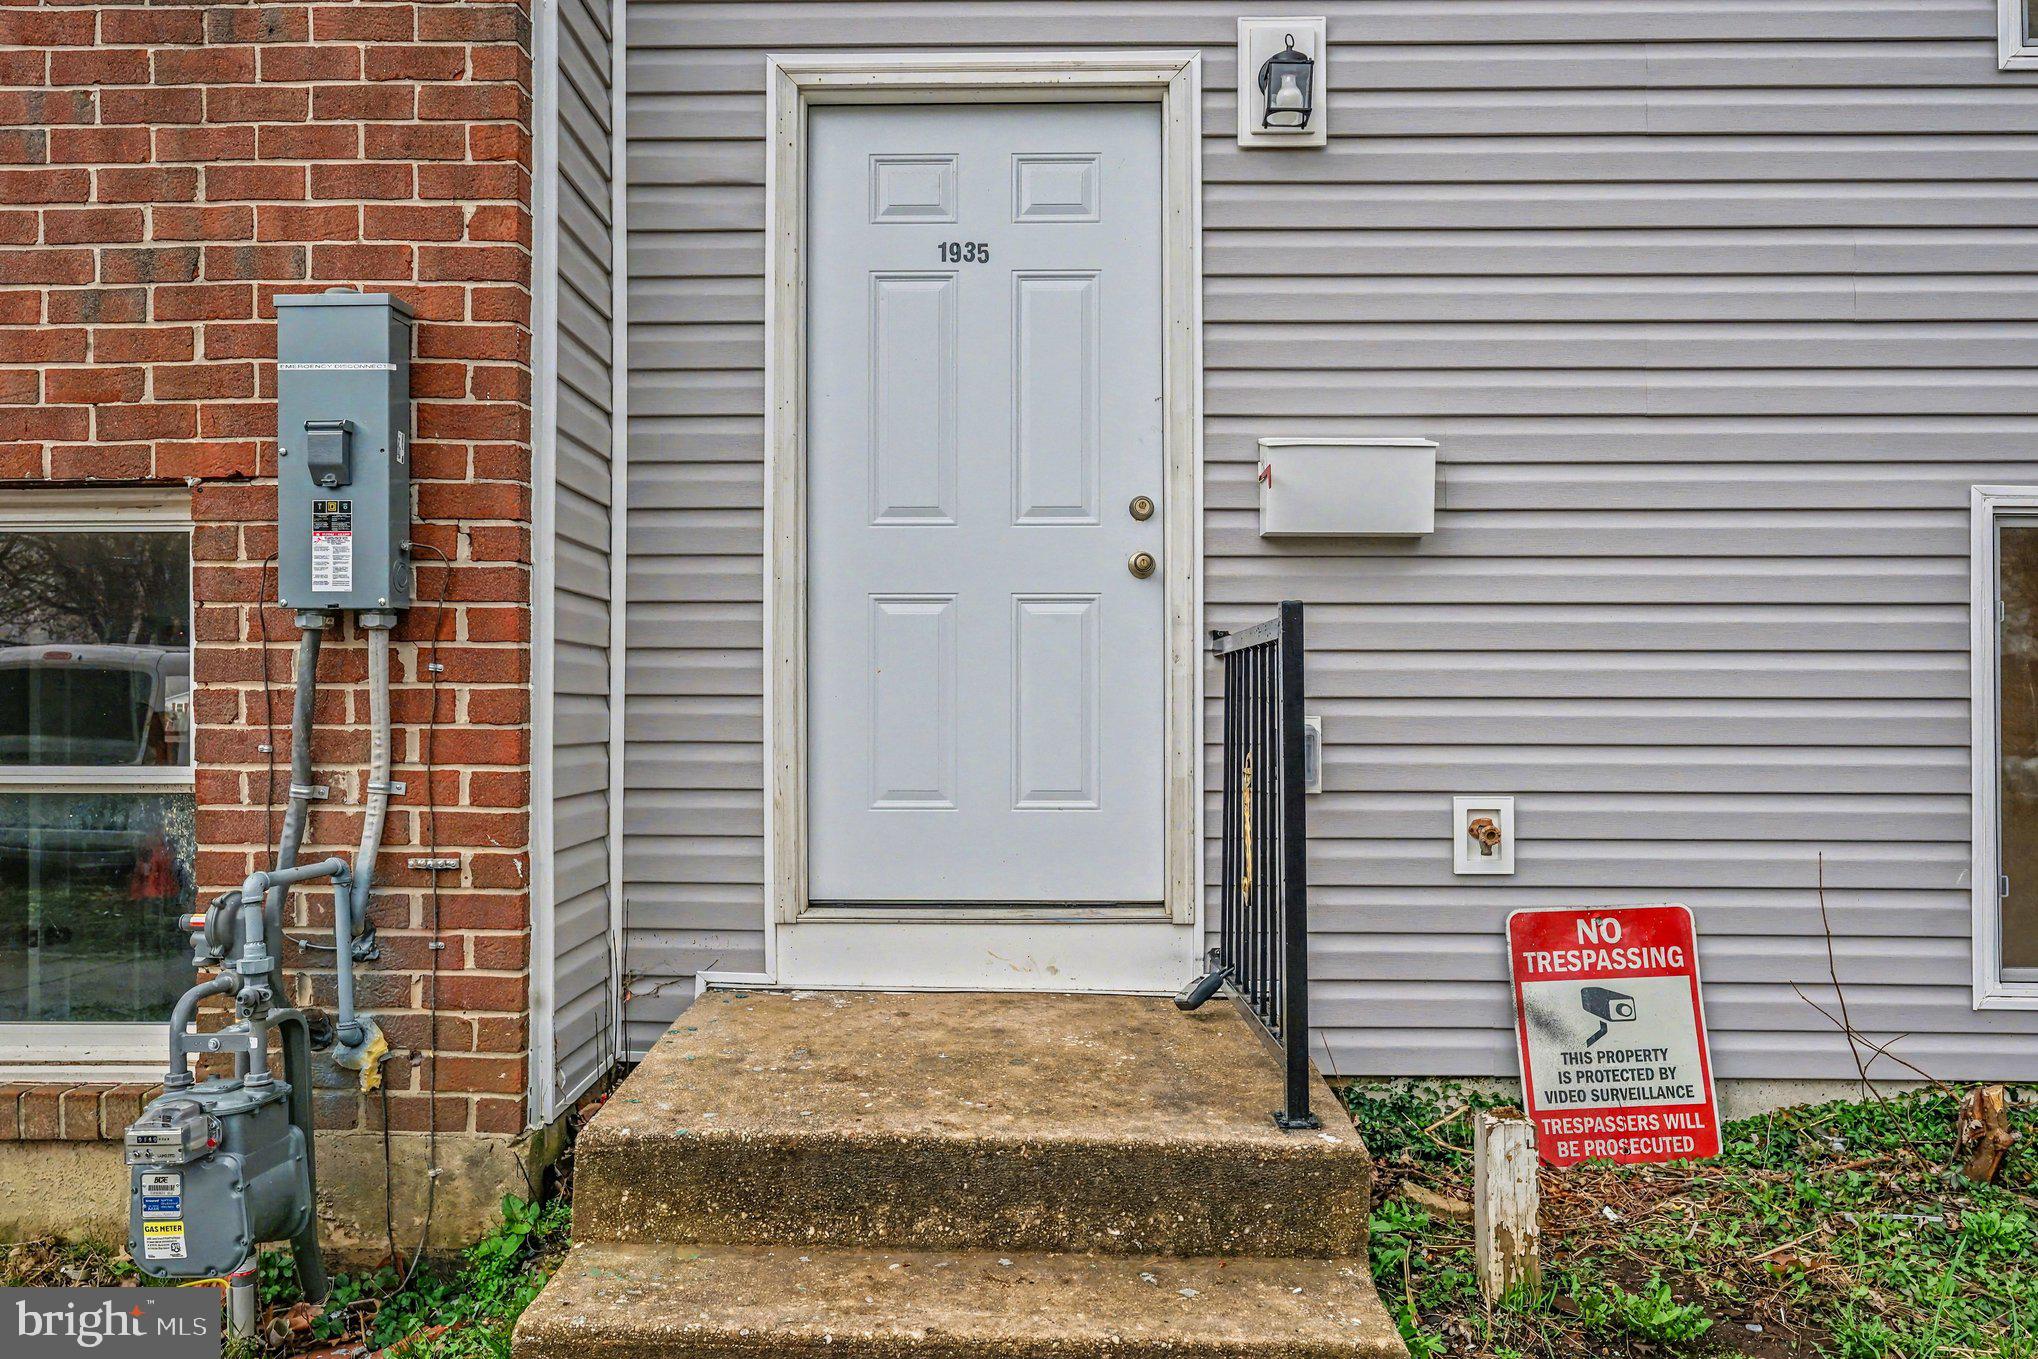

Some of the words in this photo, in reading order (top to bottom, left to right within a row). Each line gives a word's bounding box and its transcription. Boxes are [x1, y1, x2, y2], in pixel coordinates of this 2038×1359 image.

[937, 241, 990, 264] 1935
[1577, 917, 1623, 945] NO
[1522, 946, 1685, 974] TRESPASSING
[1560, 1051, 1593, 1066] THIS
[1597, 1048, 1669, 1065] PROPERTY
[1558, 1071, 1572, 1085] IS
[1576, 1068, 1654, 1085] PROTECTED
[1659, 1066, 1677, 1081] BY
[1544, 1089, 1587, 1104] VIDEO
[1591, 1085, 1695, 1103] SURVEILLANCE
[1541, 1114, 1660, 1135] TRESPASSERS
[1663, 1112, 1705, 1130] WILL
[1557, 1140, 1581, 1158] BE
[1584, 1136, 1695, 1157] PROSECUTED
[144, 1225, 159, 1233] GAS
[159, 1224, 183, 1233] METER
